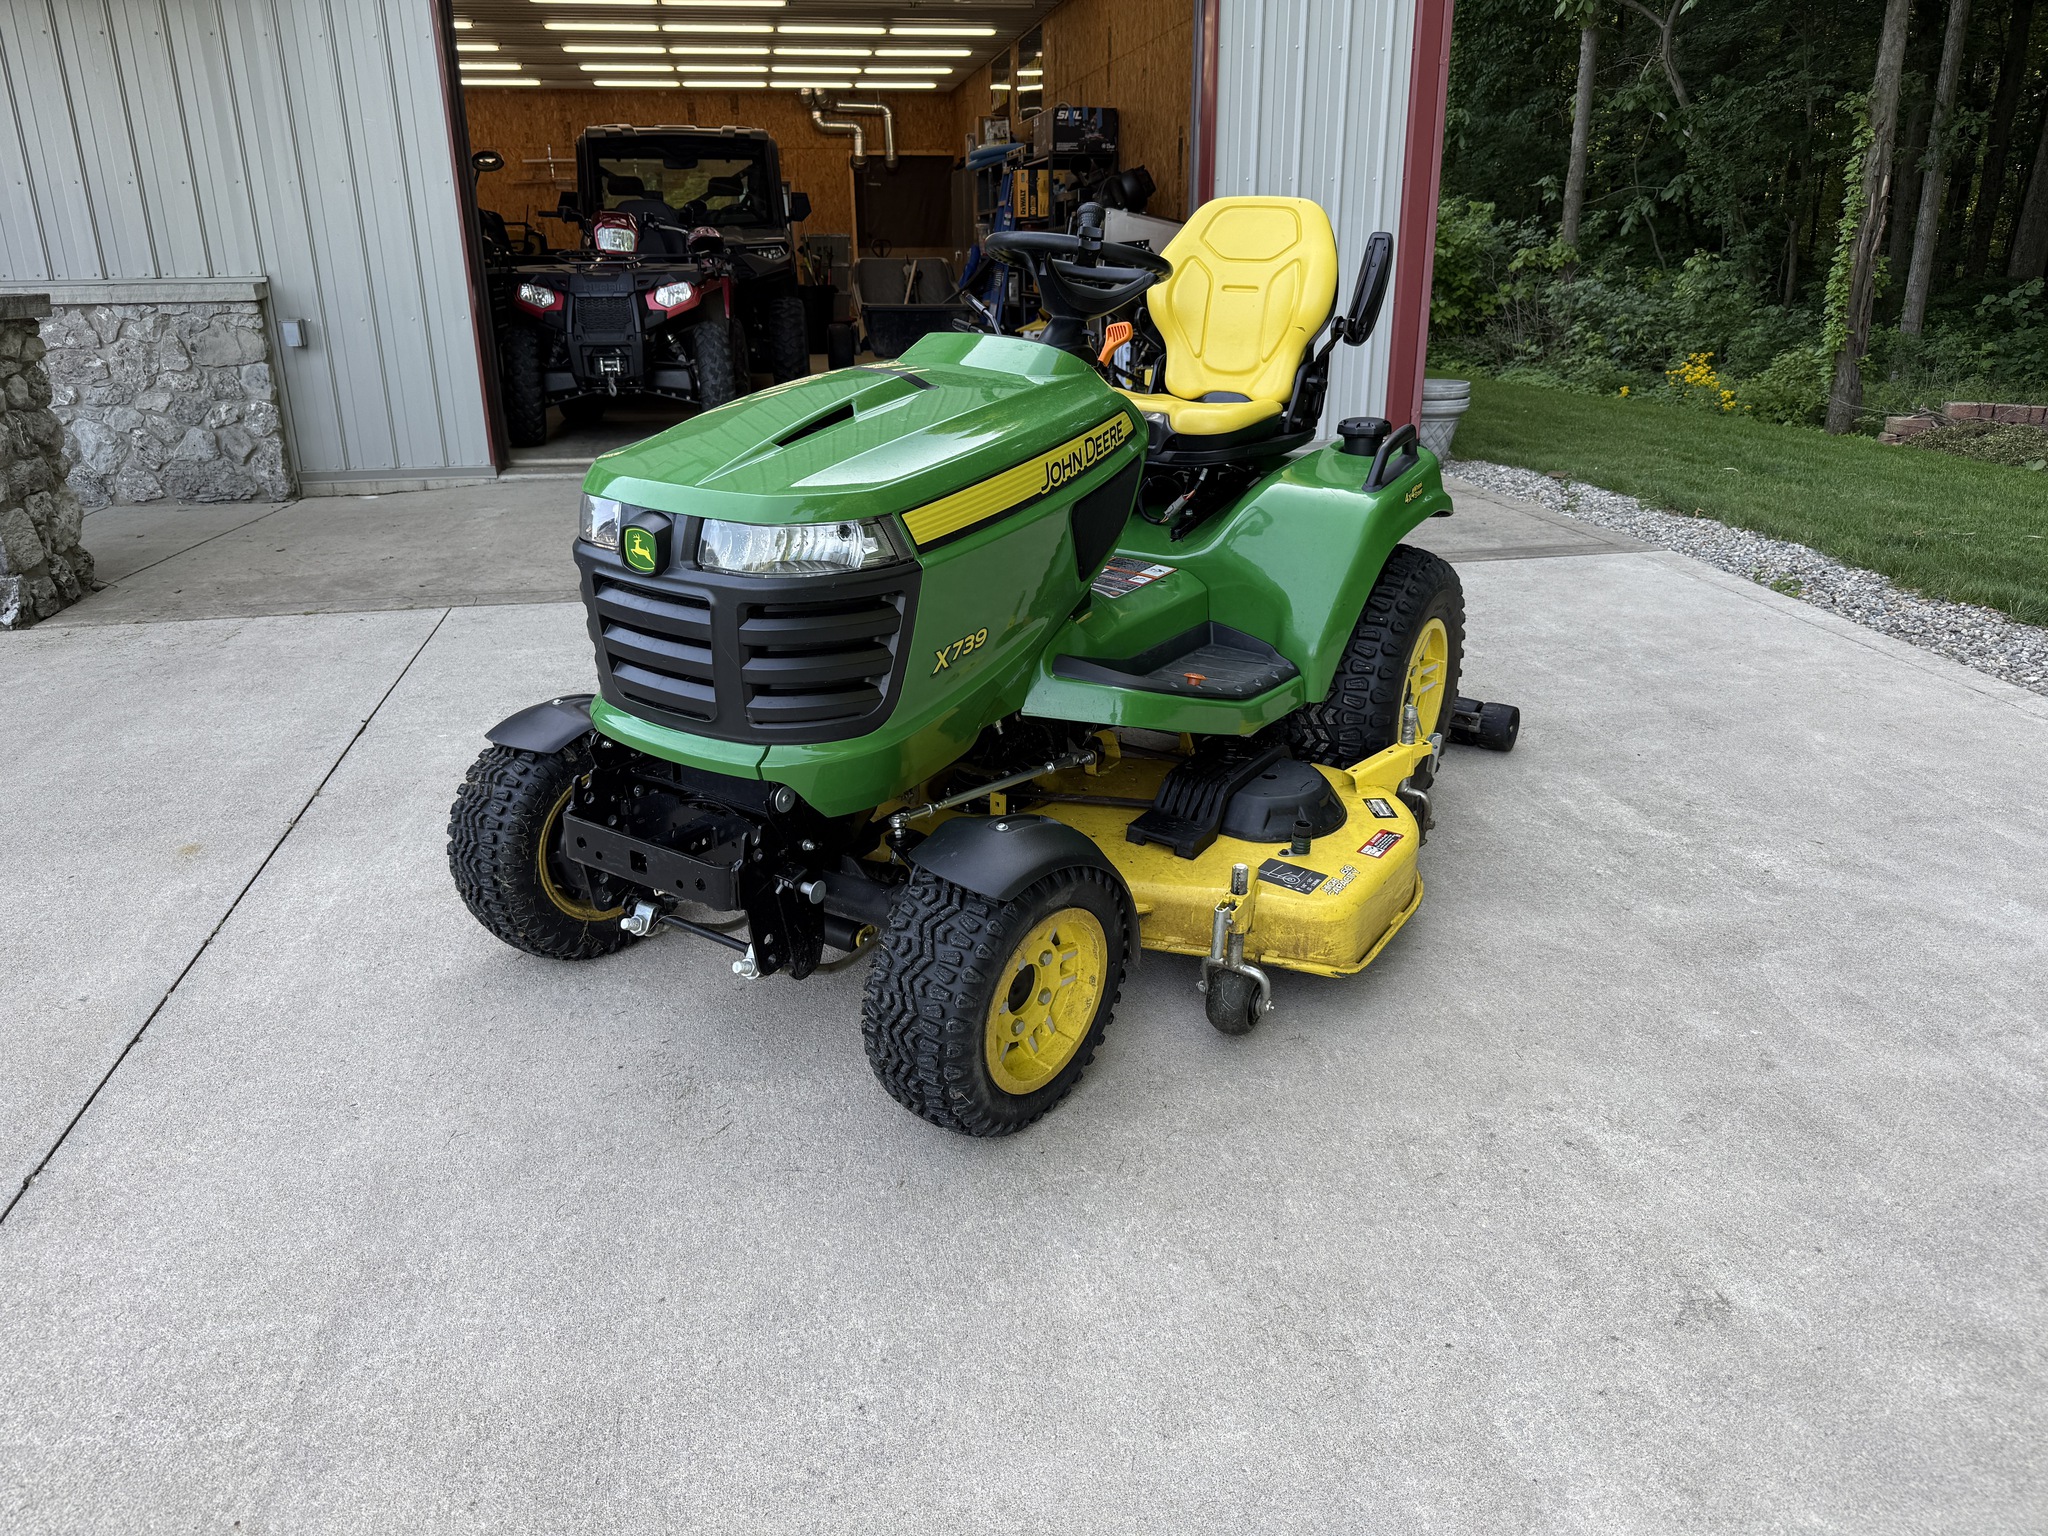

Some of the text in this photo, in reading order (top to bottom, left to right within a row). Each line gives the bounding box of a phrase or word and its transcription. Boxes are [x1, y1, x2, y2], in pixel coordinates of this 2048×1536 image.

[1041, 420, 1125, 493] JOHN DEERE
[930, 627, 989, 678] X739
